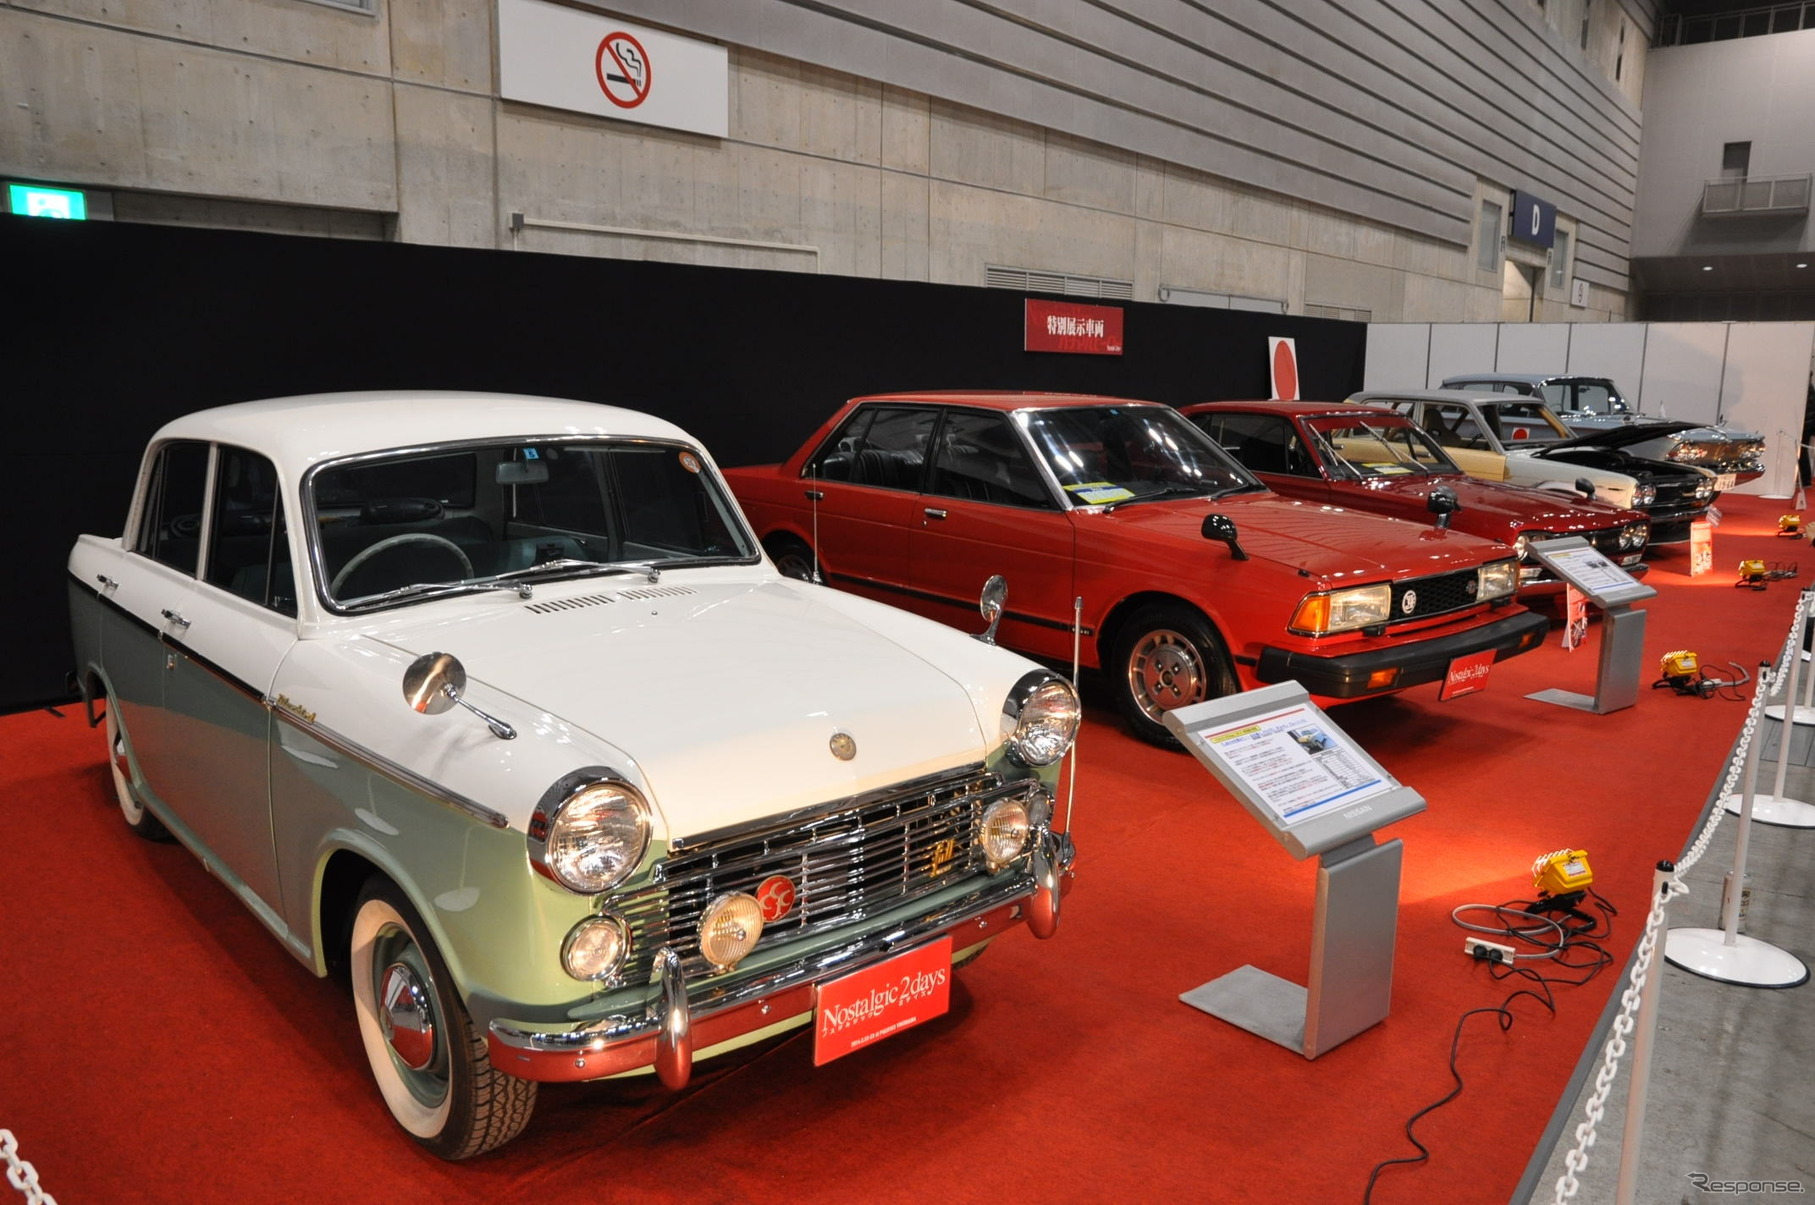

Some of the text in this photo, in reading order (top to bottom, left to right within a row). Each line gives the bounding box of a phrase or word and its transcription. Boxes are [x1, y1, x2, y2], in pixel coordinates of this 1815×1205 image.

[1531, 204, 1541, 236] D
[1047, 315, 1104, 338] 特別展示車両
[823, 968, 946, 1032] Nostalgic 2days
